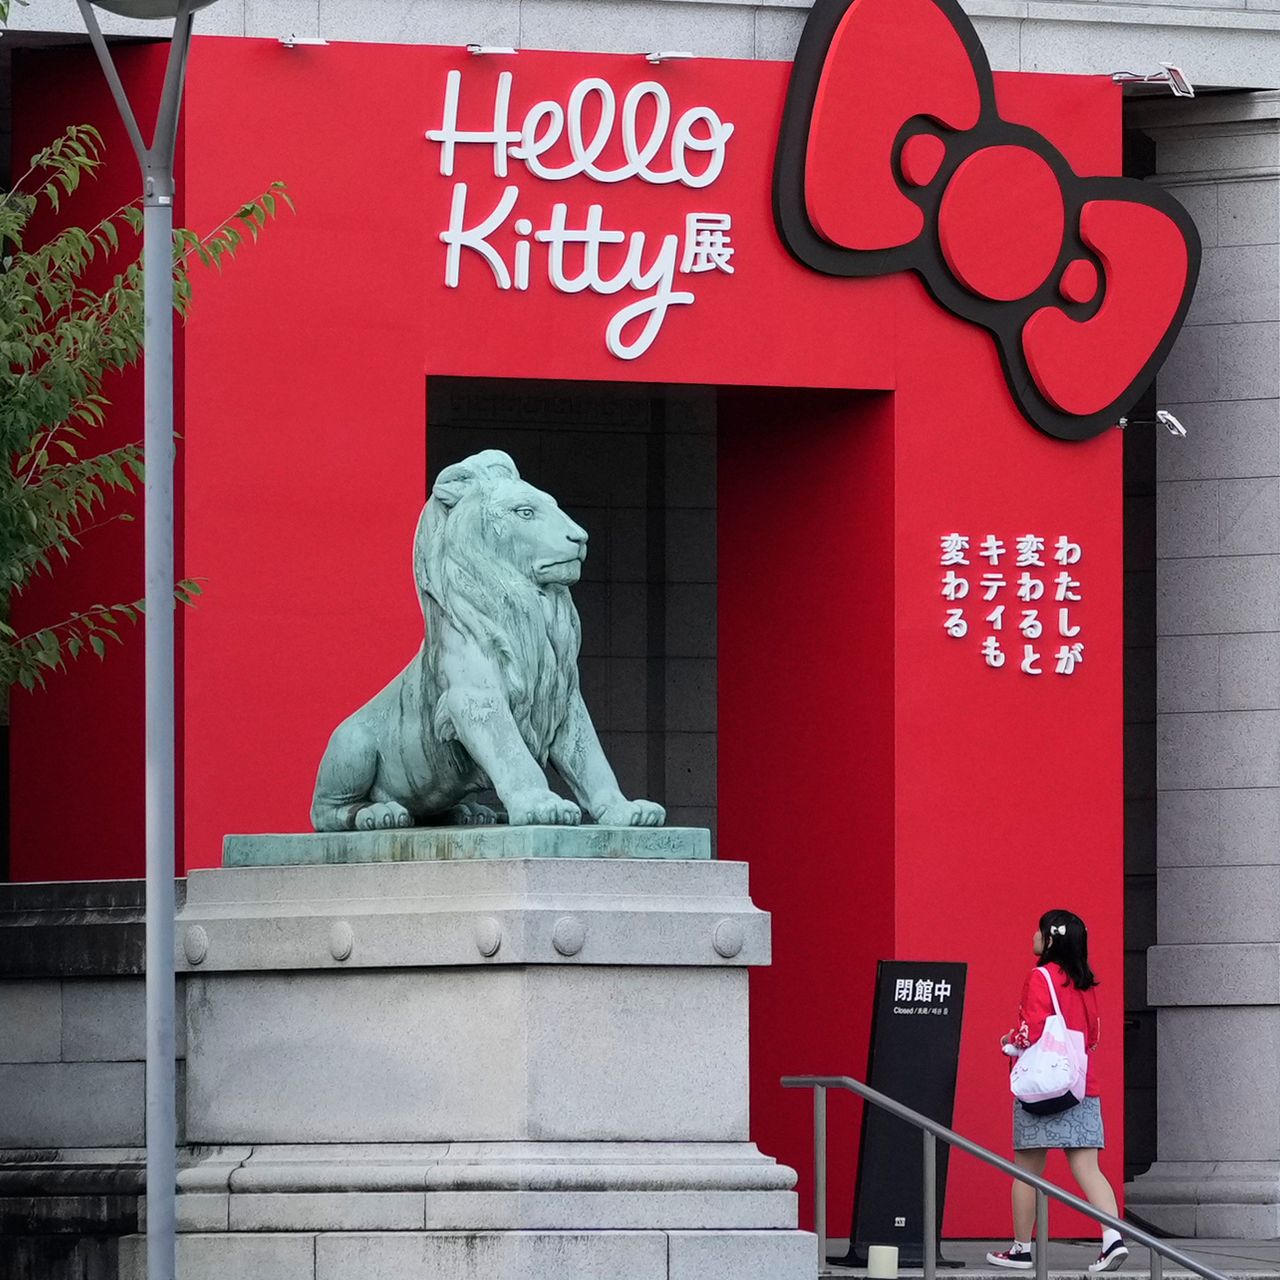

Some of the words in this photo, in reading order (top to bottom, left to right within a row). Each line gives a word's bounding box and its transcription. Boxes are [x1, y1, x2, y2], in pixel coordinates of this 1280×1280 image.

[425, 69, 735, 188] Hello
[940, 532, 971, 638] 変わる
[978, 534, 1007, 668] キティも
[1015, 533, 1046, 675] 変わると
[1053, 535, 1085, 675] わたしが
[894, 978, 952, 1003] 閉館中
